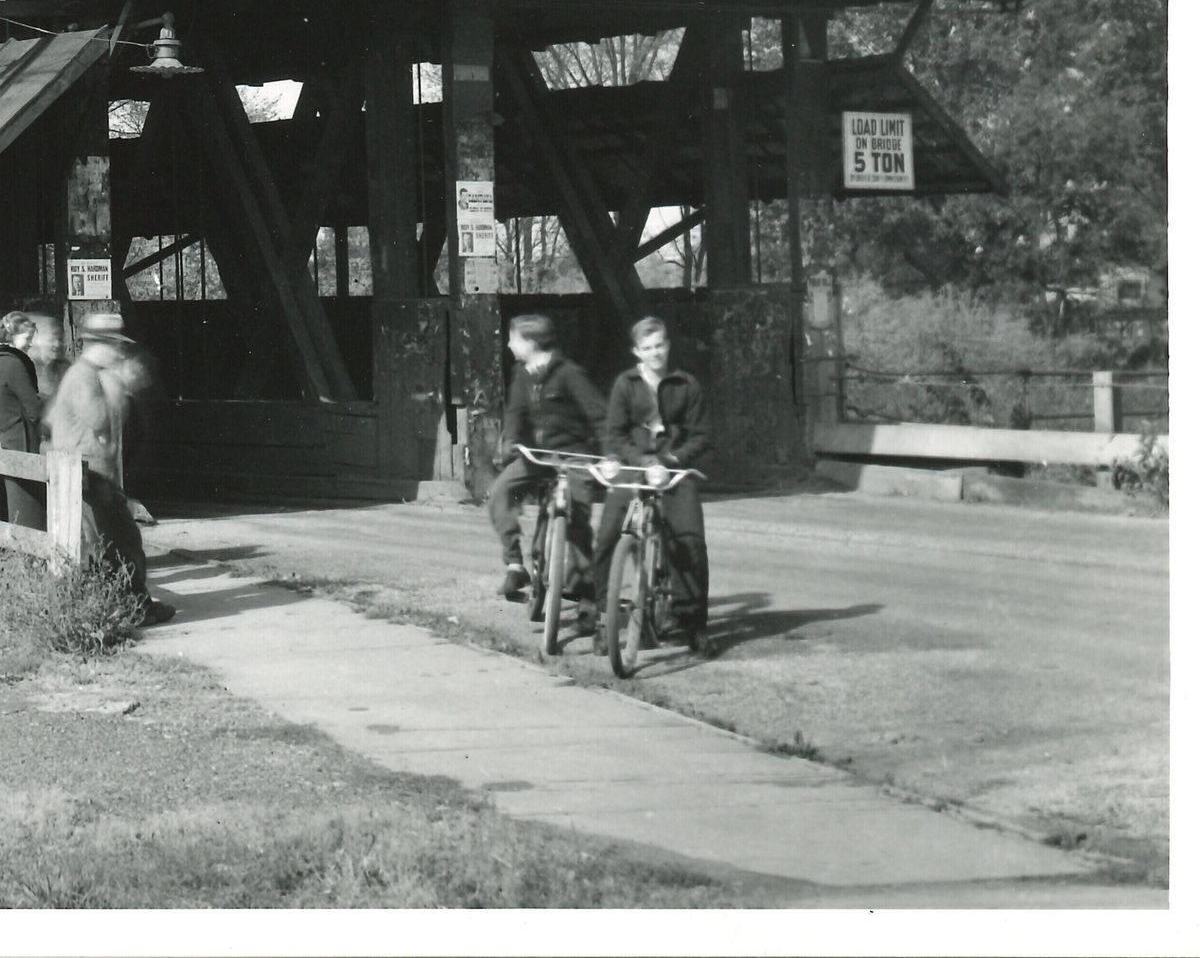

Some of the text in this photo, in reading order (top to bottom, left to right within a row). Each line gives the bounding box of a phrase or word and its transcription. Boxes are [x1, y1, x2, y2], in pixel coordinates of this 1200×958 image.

[852, 118, 905, 136] LOAD LIMIT
[856, 137, 902, 151] ON BRIDGE
[854, 151, 905, 173] 5 TON
